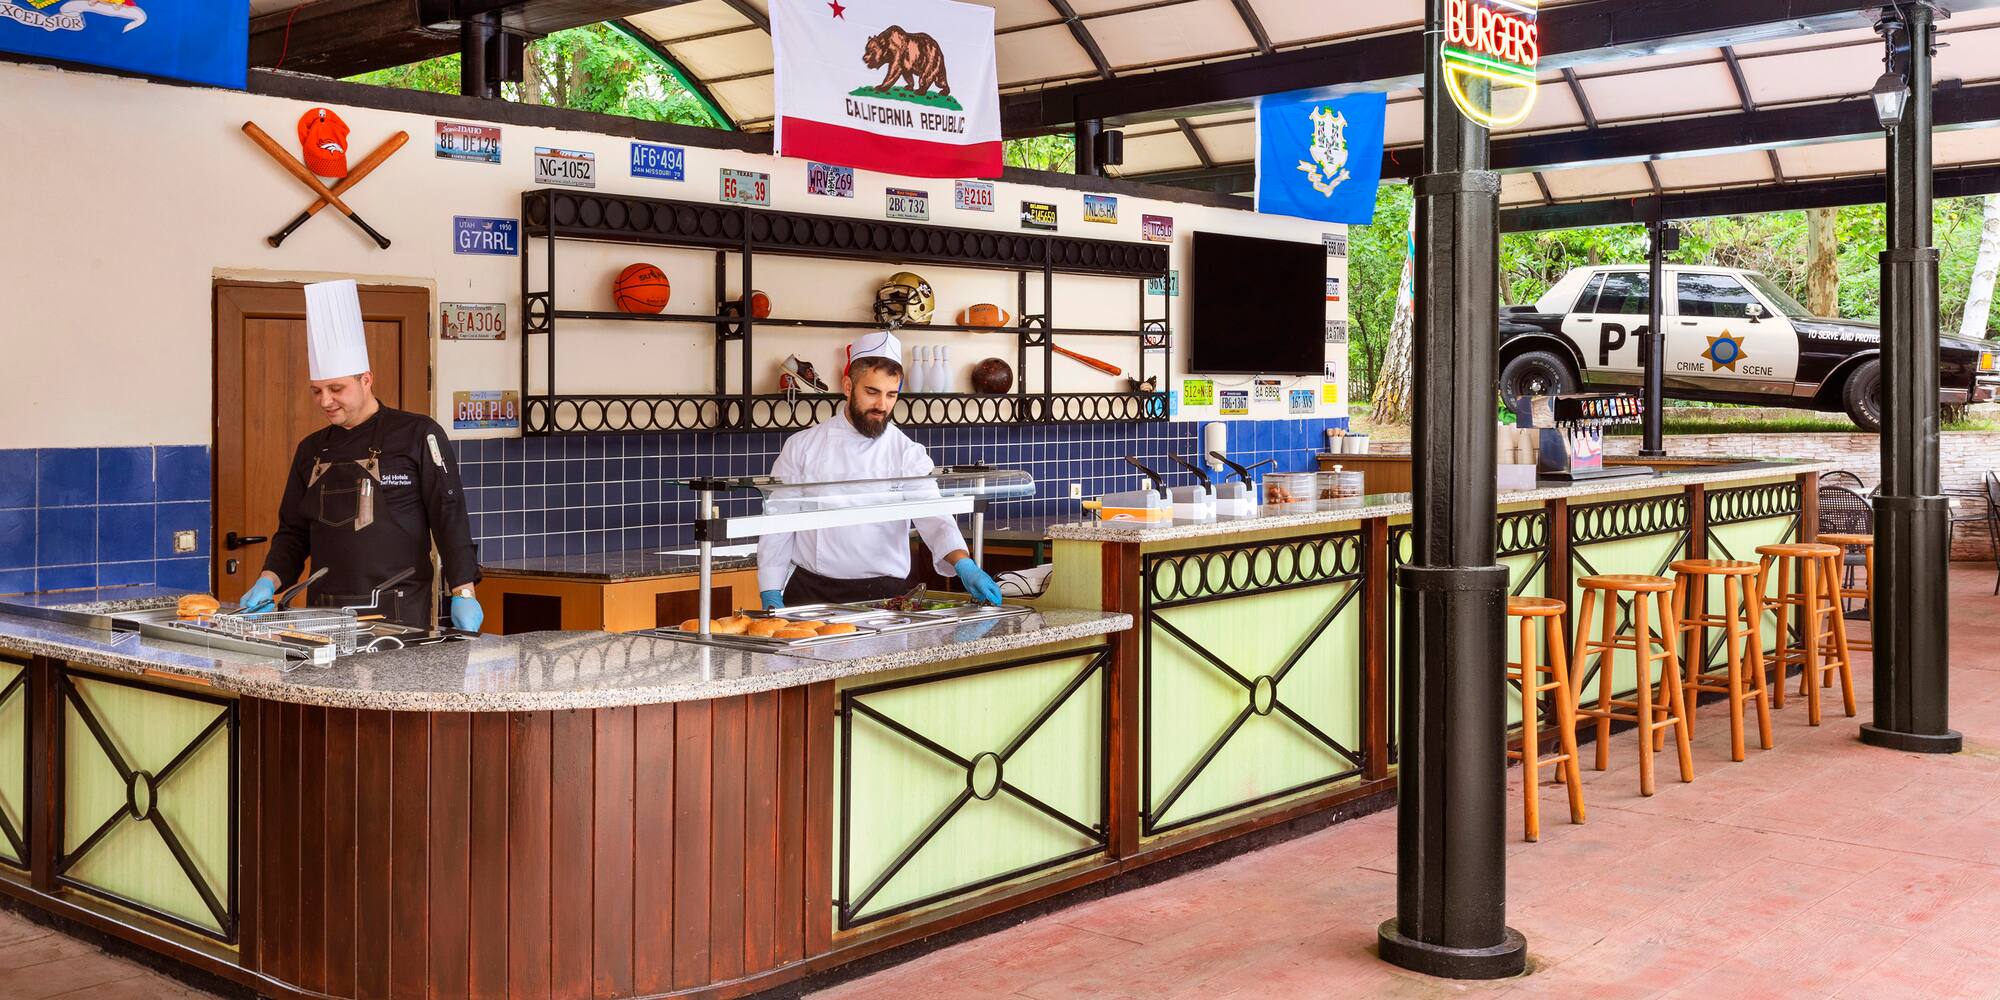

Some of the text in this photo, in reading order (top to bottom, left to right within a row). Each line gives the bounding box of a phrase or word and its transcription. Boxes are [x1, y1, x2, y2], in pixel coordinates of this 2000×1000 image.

[0, 4, 81, 29] XCELSIOR
[1448, 0, 1537, 65] BURGERS
[846, 98, 965, 134] CALIFORNIA REPUBLIC
[458, 126, 482, 134] IDAHO
[540, 158, 590, 179] NG-1052
[646, 168, 672, 176] MISSOURI
[724, 177, 766, 201] EG 39
[835, 172, 852, 190] 269
[909, 199, 925, 213] 732
[459, 221, 476, 229] UTAH
[459, 229, 514, 251] G7RRL
[1598, 322, 1649, 366] P1
[1808, 329, 1880, 344] TO SERVE AND PROTEC
[1676, 361, 1773, 376] CRIME SCENE
[458, 401, 514, 421] GR8 PL8
